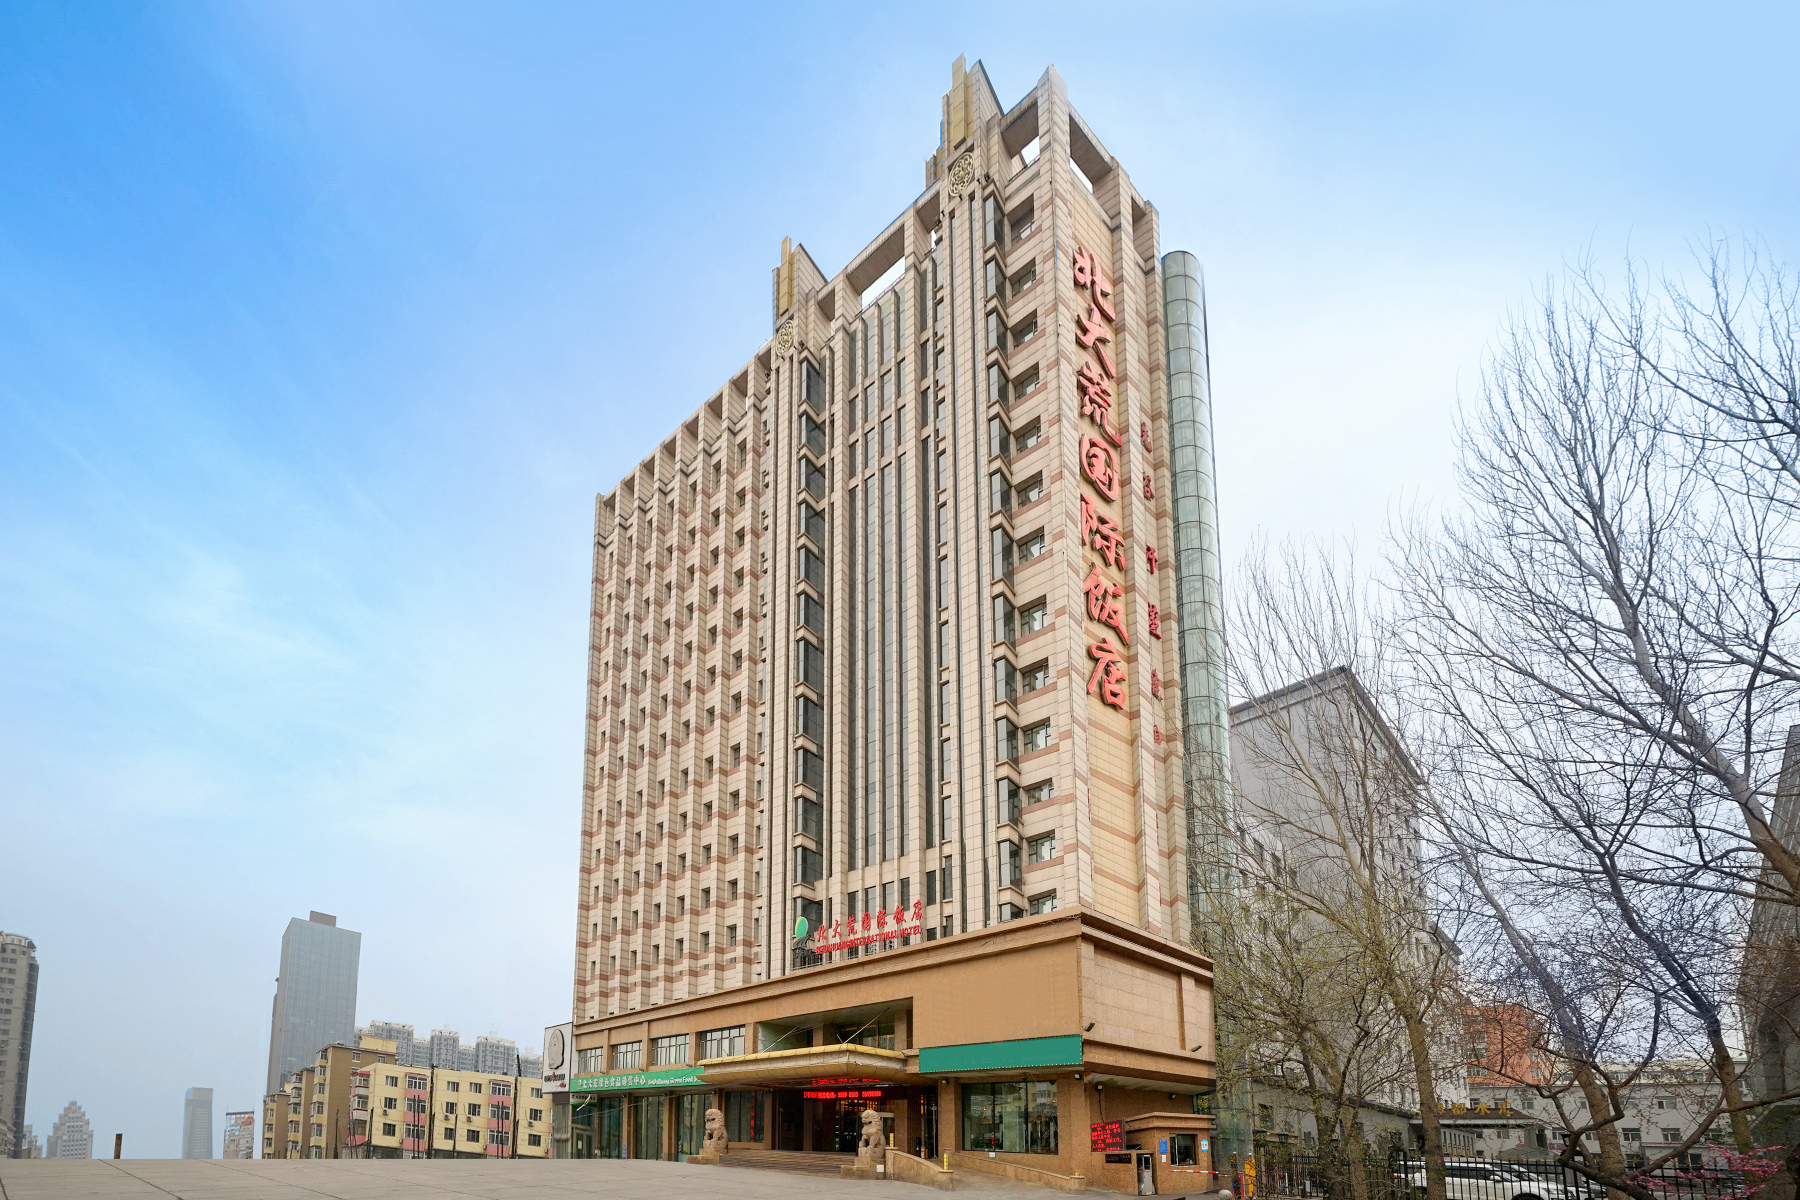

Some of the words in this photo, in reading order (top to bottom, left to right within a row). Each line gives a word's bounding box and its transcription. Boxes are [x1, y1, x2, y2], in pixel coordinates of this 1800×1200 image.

[1073, 246, 1129, 711] 北大荒国际饭店
[816, 899, 923, 942] 北大荒国际饭店
[899, 925, 922, 938] HOTEL
